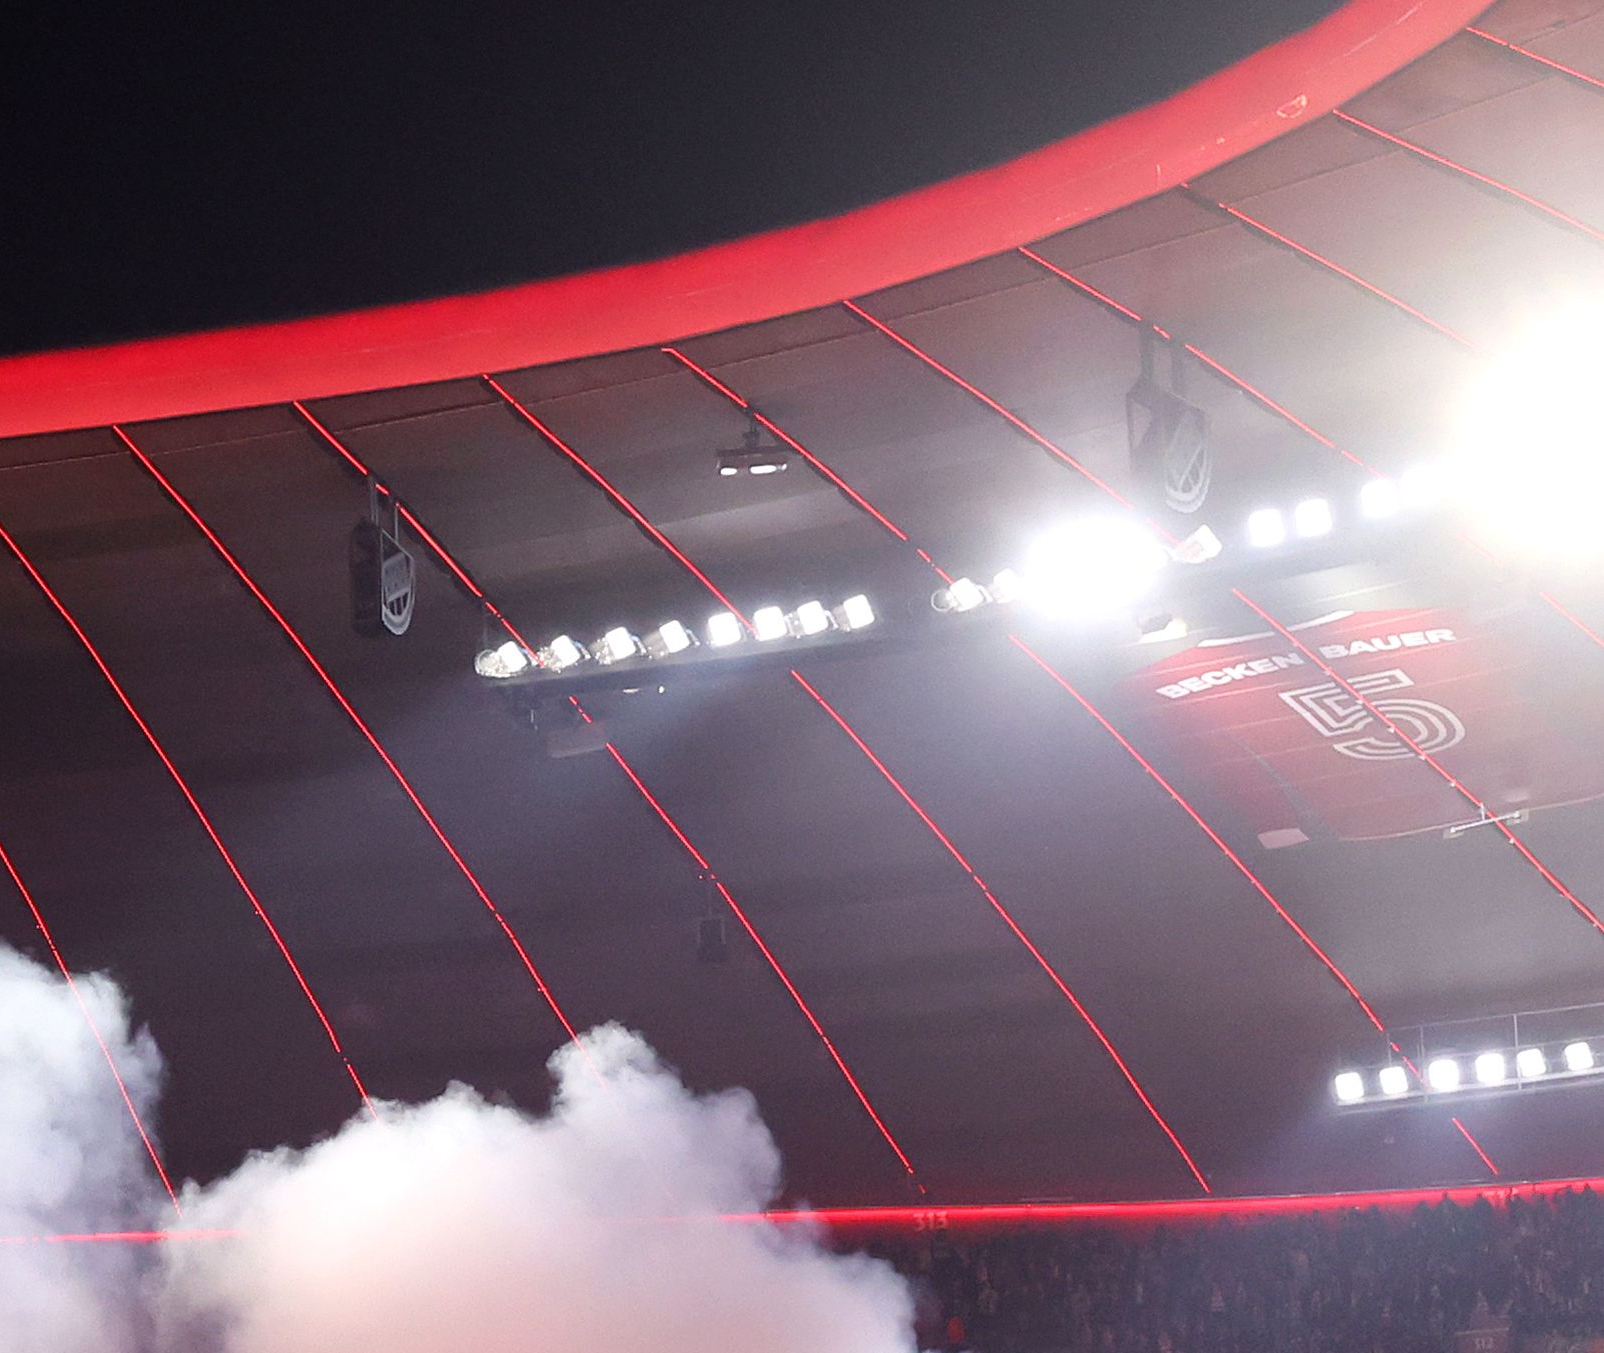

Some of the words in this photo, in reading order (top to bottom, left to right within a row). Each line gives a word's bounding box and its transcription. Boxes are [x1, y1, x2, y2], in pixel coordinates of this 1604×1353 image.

[1156, 652, 1305, 698] BECKEN
[1319, 628, 1457, 659] BAUER
[1278, 668, 1466, 761] 5
